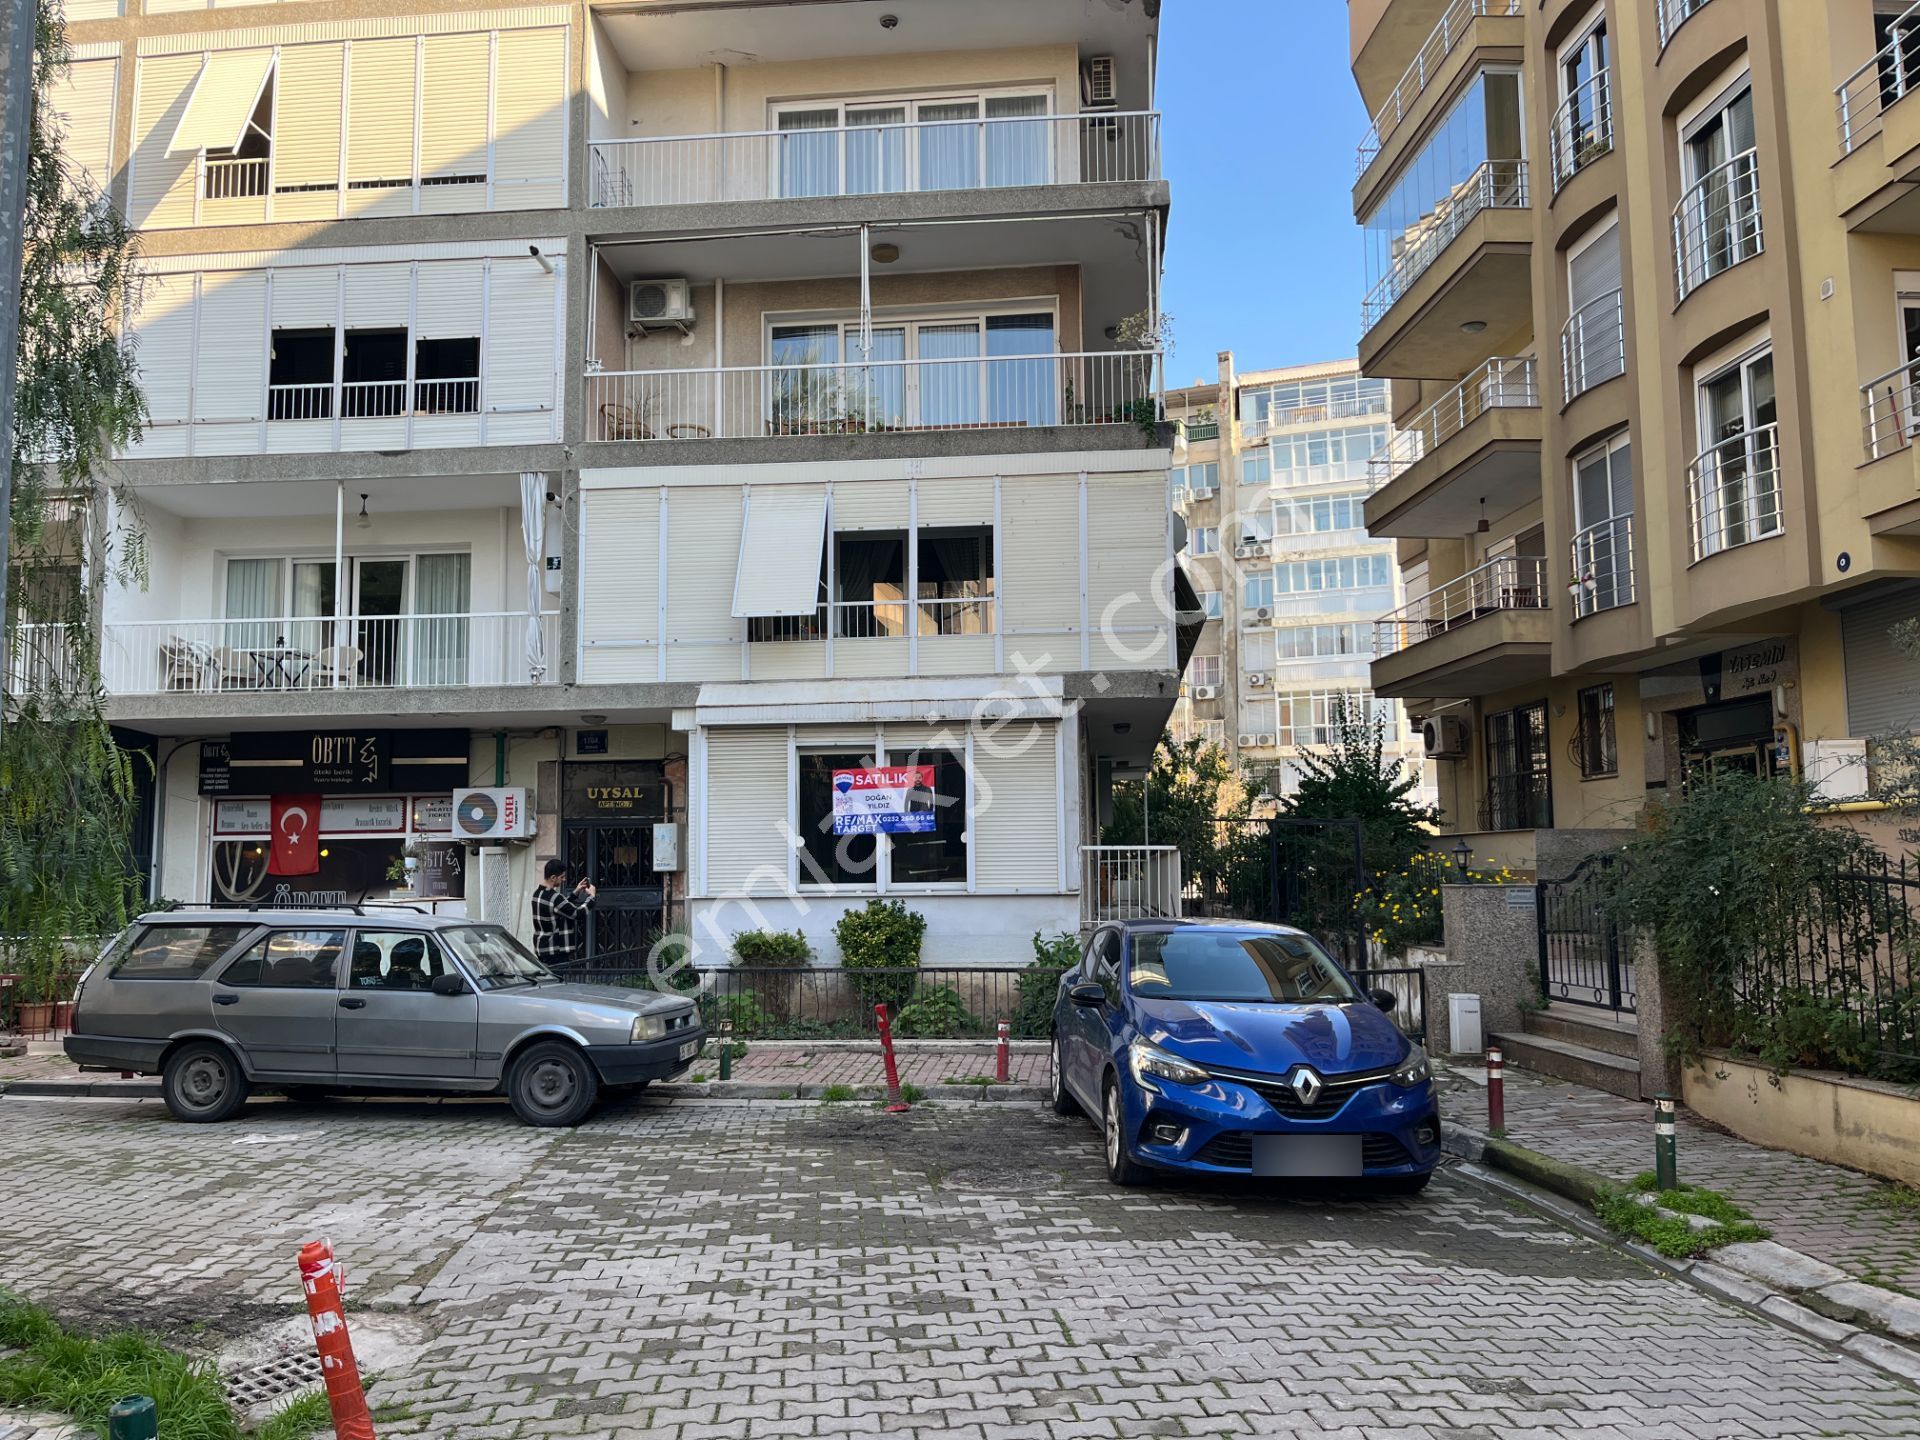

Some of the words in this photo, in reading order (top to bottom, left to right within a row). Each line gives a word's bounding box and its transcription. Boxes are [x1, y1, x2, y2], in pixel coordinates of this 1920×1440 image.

[312, 733, 356, 764] ÖBTT
[855, 772, 909, 786] SATILIK
[586, 786, 644, 799] UYSAL
[865, 793, 892, 802] DOĞAN
[504, 793, 514, 831] VESTEL
[835, 814, 882, 826] RE/MAX
[836, 824, 878, 834] TARGET
